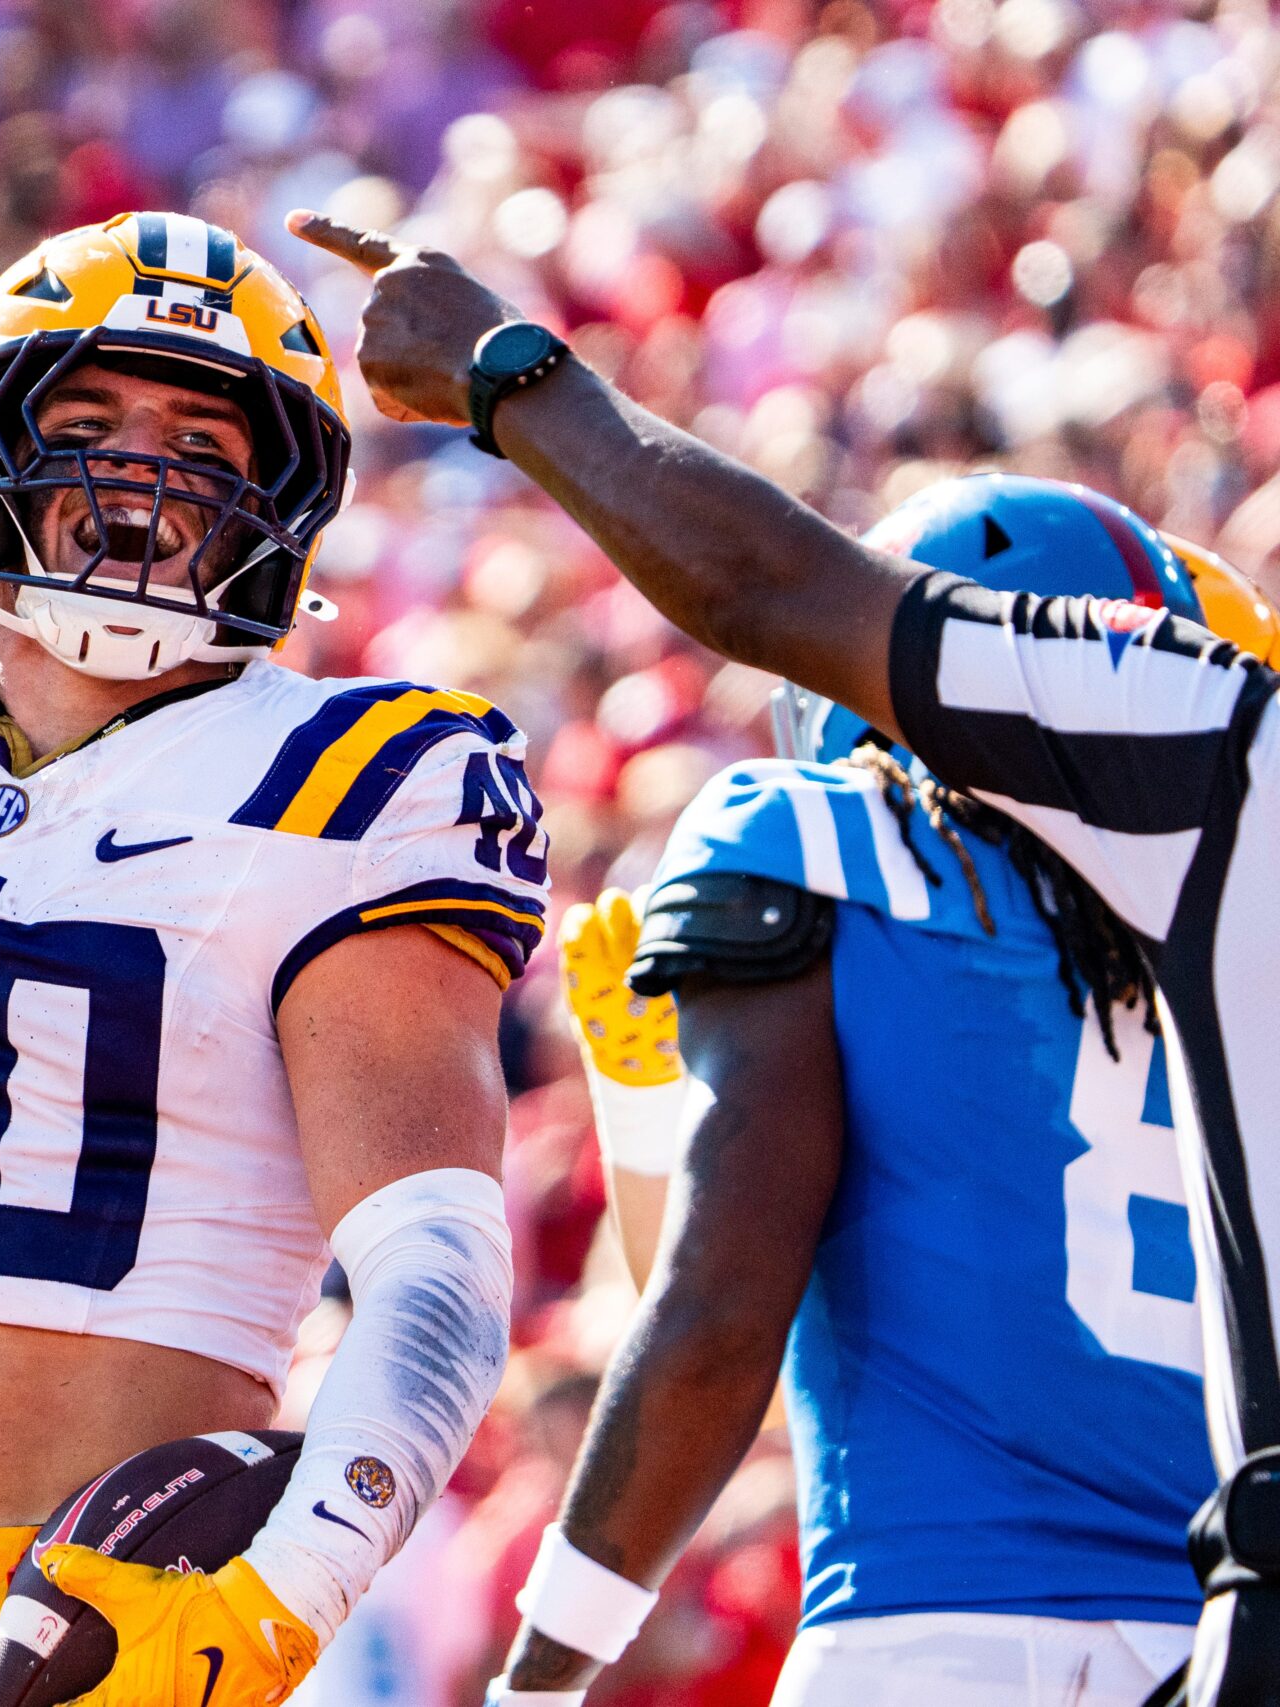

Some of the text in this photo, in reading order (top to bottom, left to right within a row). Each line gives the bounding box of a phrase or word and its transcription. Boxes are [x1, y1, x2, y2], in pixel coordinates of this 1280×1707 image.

[145, 299, 218, 333] LSU
[453, 752, 551, 886] 40
[96, 1468, 205, 1557] APOR ELITE
